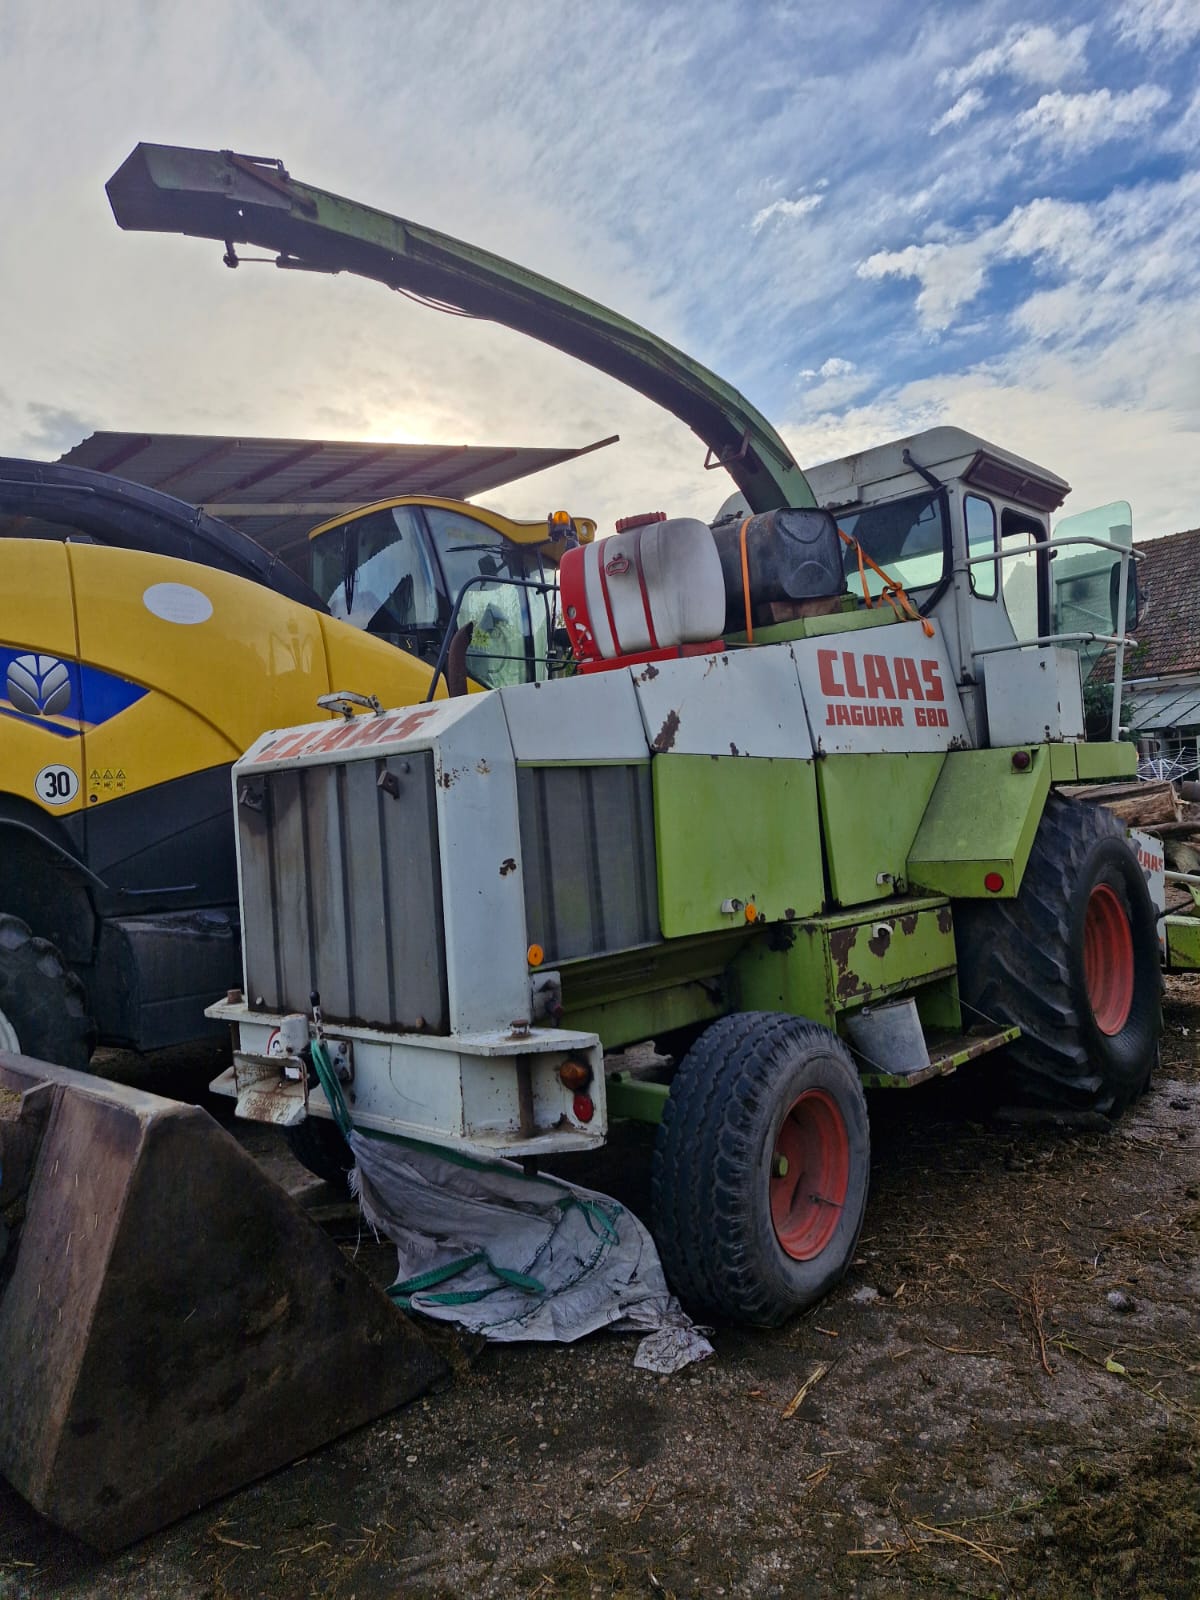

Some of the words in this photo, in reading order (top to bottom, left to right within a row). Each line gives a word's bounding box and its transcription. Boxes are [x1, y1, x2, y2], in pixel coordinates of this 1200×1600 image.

[817, 649, 945, 701] CLAAS
[826, 704, 904, 727] JAGUAR
[914, 707, 948, 727] 680
[254, 708, 440, 763] CLAAS
[44, 771, 70, 798] 30
[1138, 849, 1163, 872] LAAS
